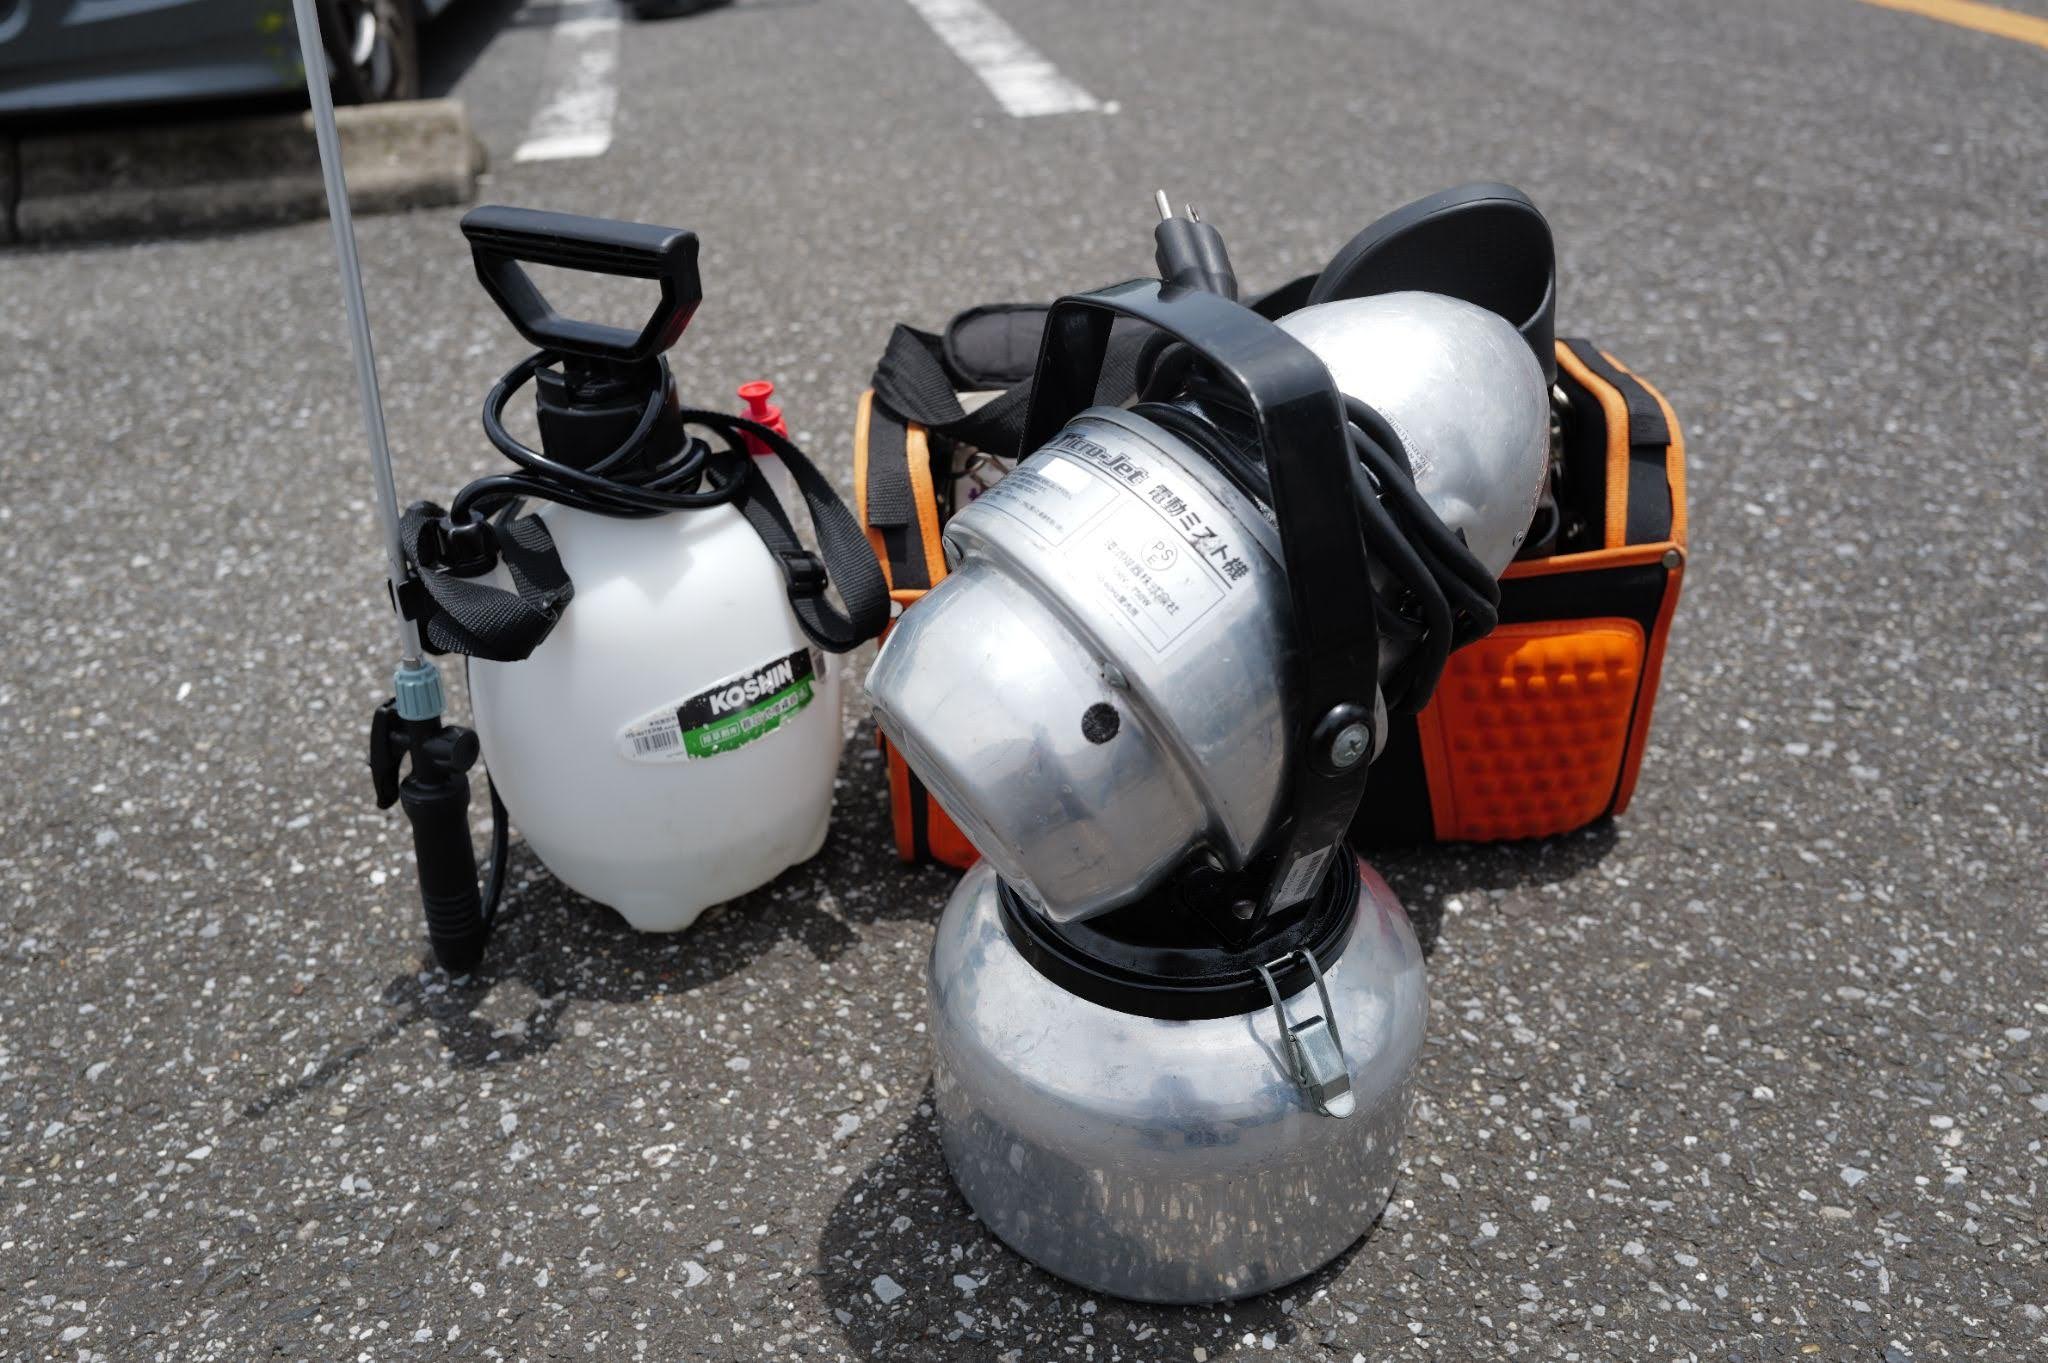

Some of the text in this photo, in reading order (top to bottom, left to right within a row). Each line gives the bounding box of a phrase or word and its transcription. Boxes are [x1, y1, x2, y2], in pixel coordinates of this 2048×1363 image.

[1148, 484, 1250, 581] 電動ミスト機
[709, 659, 795, 715] KOSHIN
